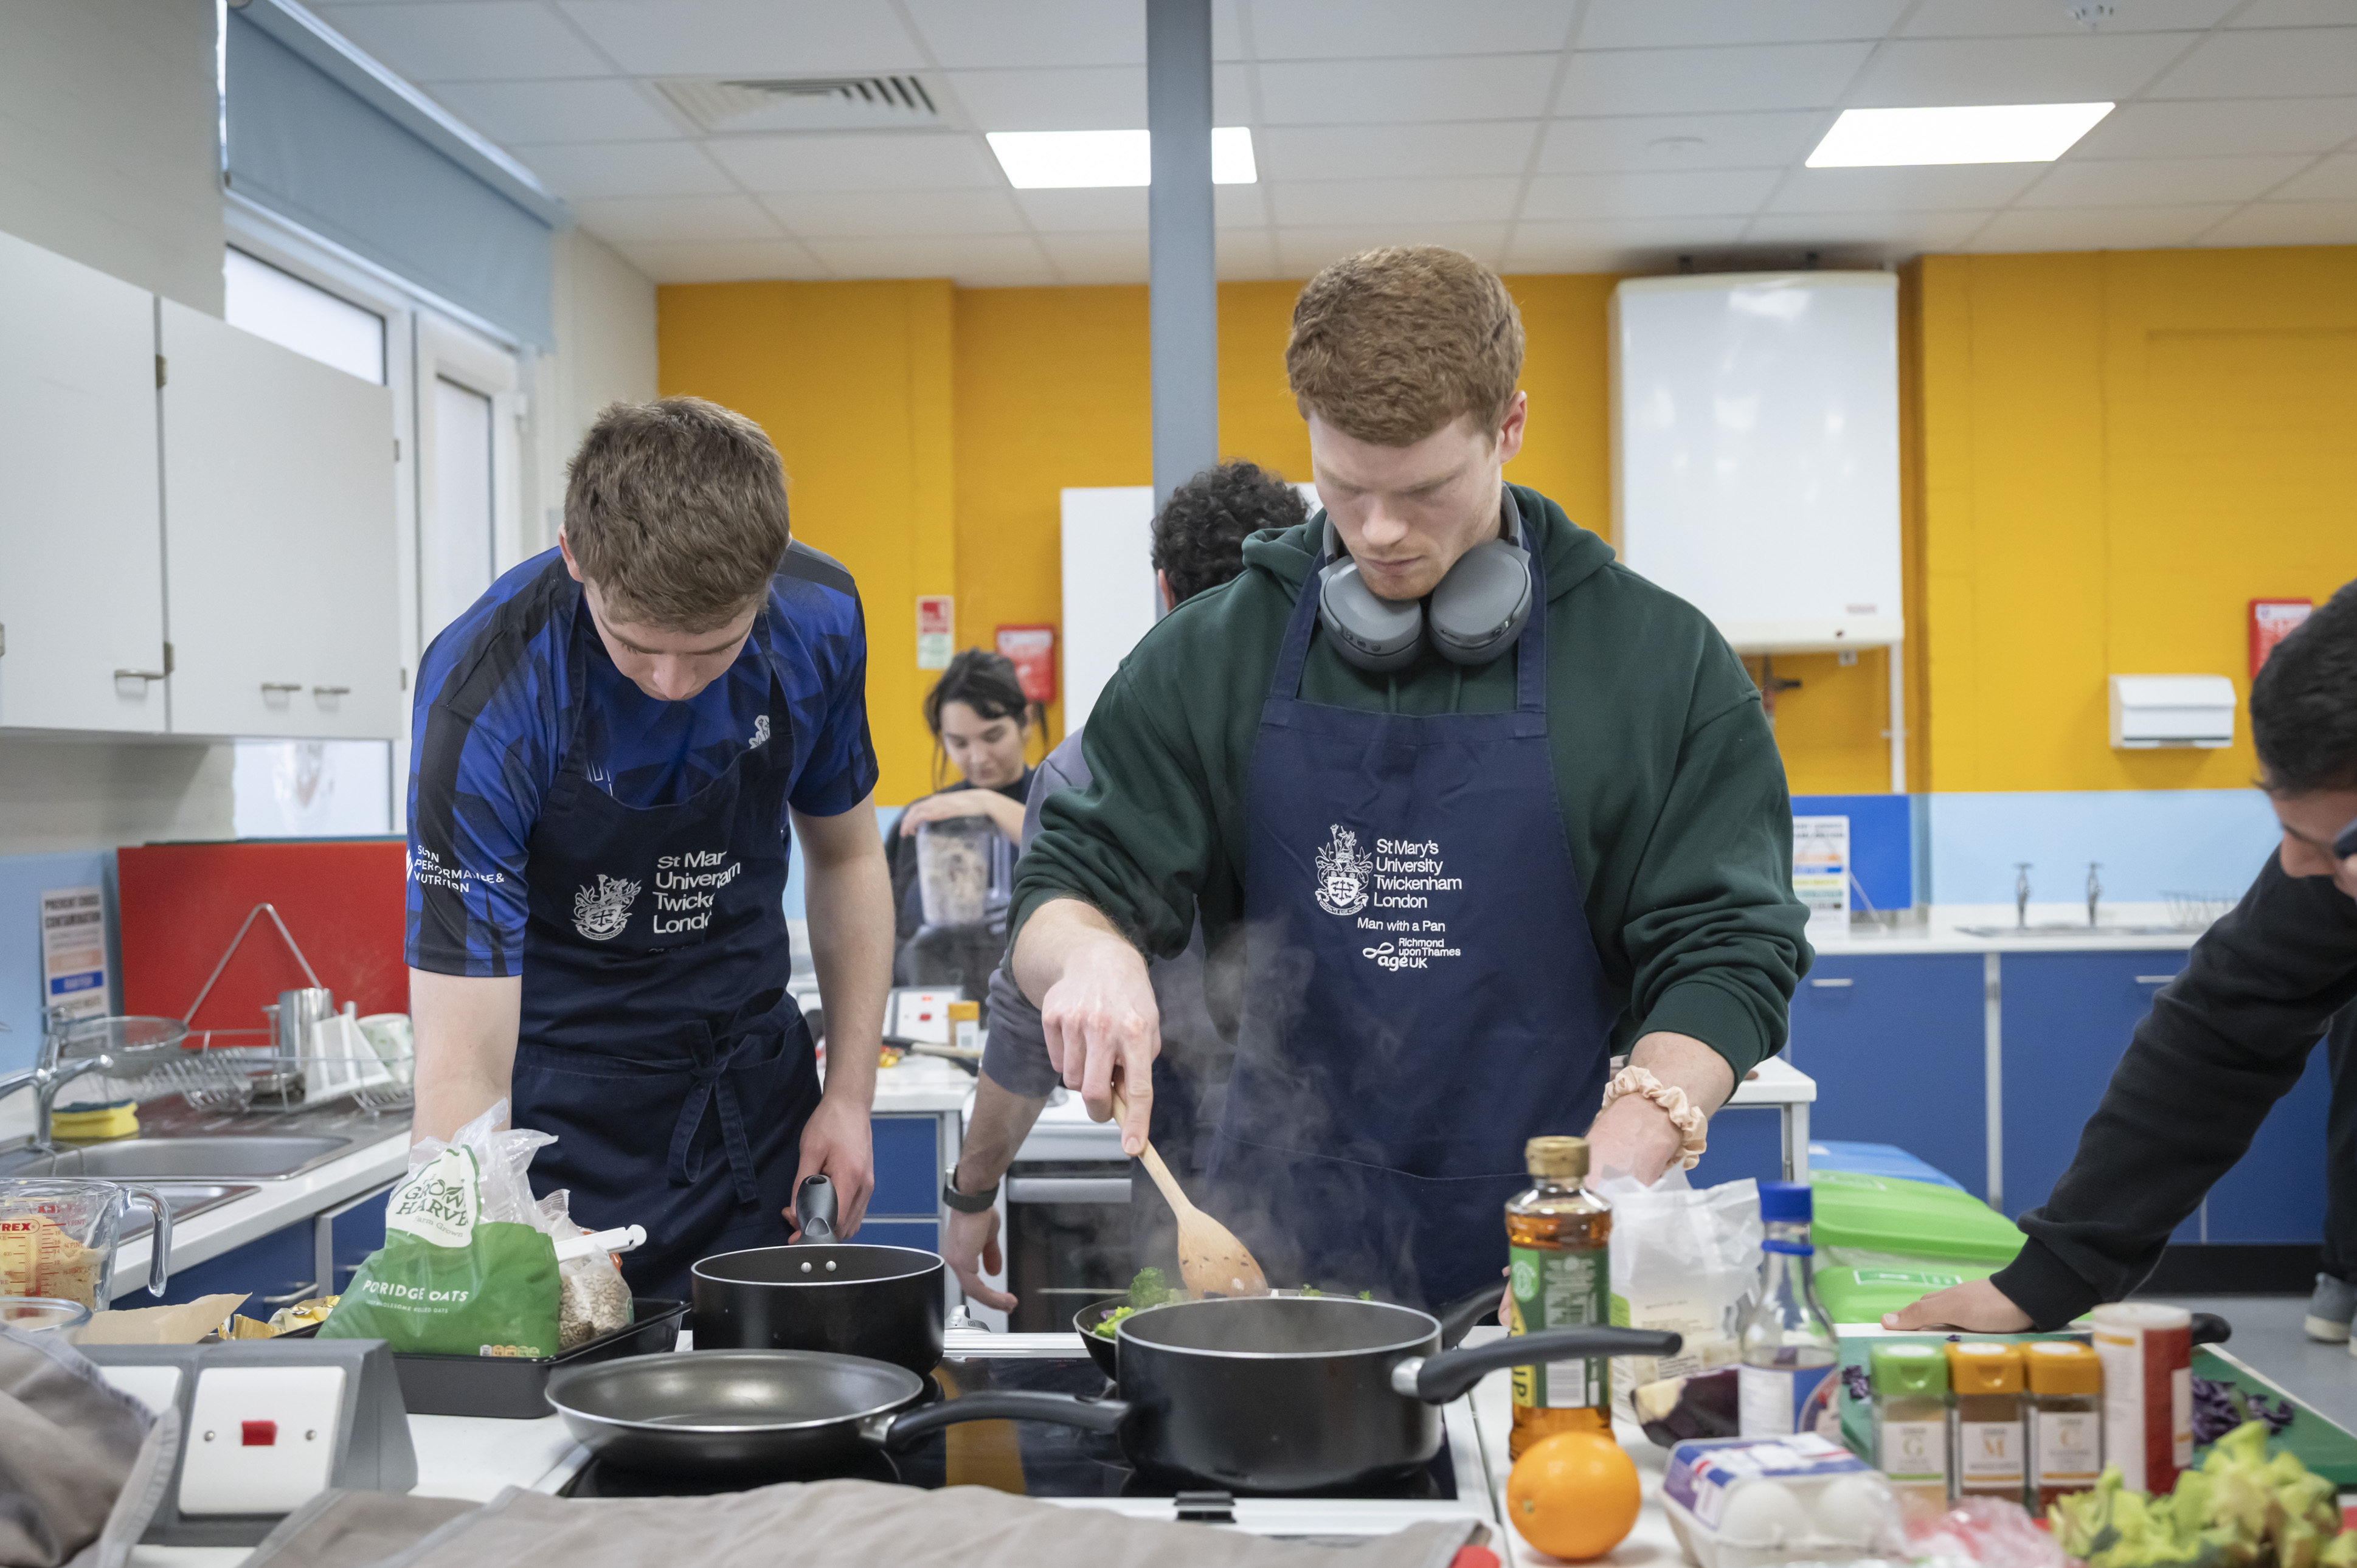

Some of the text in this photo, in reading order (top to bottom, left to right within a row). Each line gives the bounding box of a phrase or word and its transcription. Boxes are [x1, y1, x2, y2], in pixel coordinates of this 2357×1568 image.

[1376, 838, 1439, 858] St Mary's
[657, 856, 681, 869] St
[1376, 857, 1444, 876] University
[1373, 874, 1462, 891] Twickenham
[1374, 892, 1428, 908] London
[1357, 917, 1445, 932] Man with a Pan
[1399, 938, 1445, 948] Richmond
[436, 1222, 463, 1237] Grown
[429, 1291, 469, 1302] OATS
